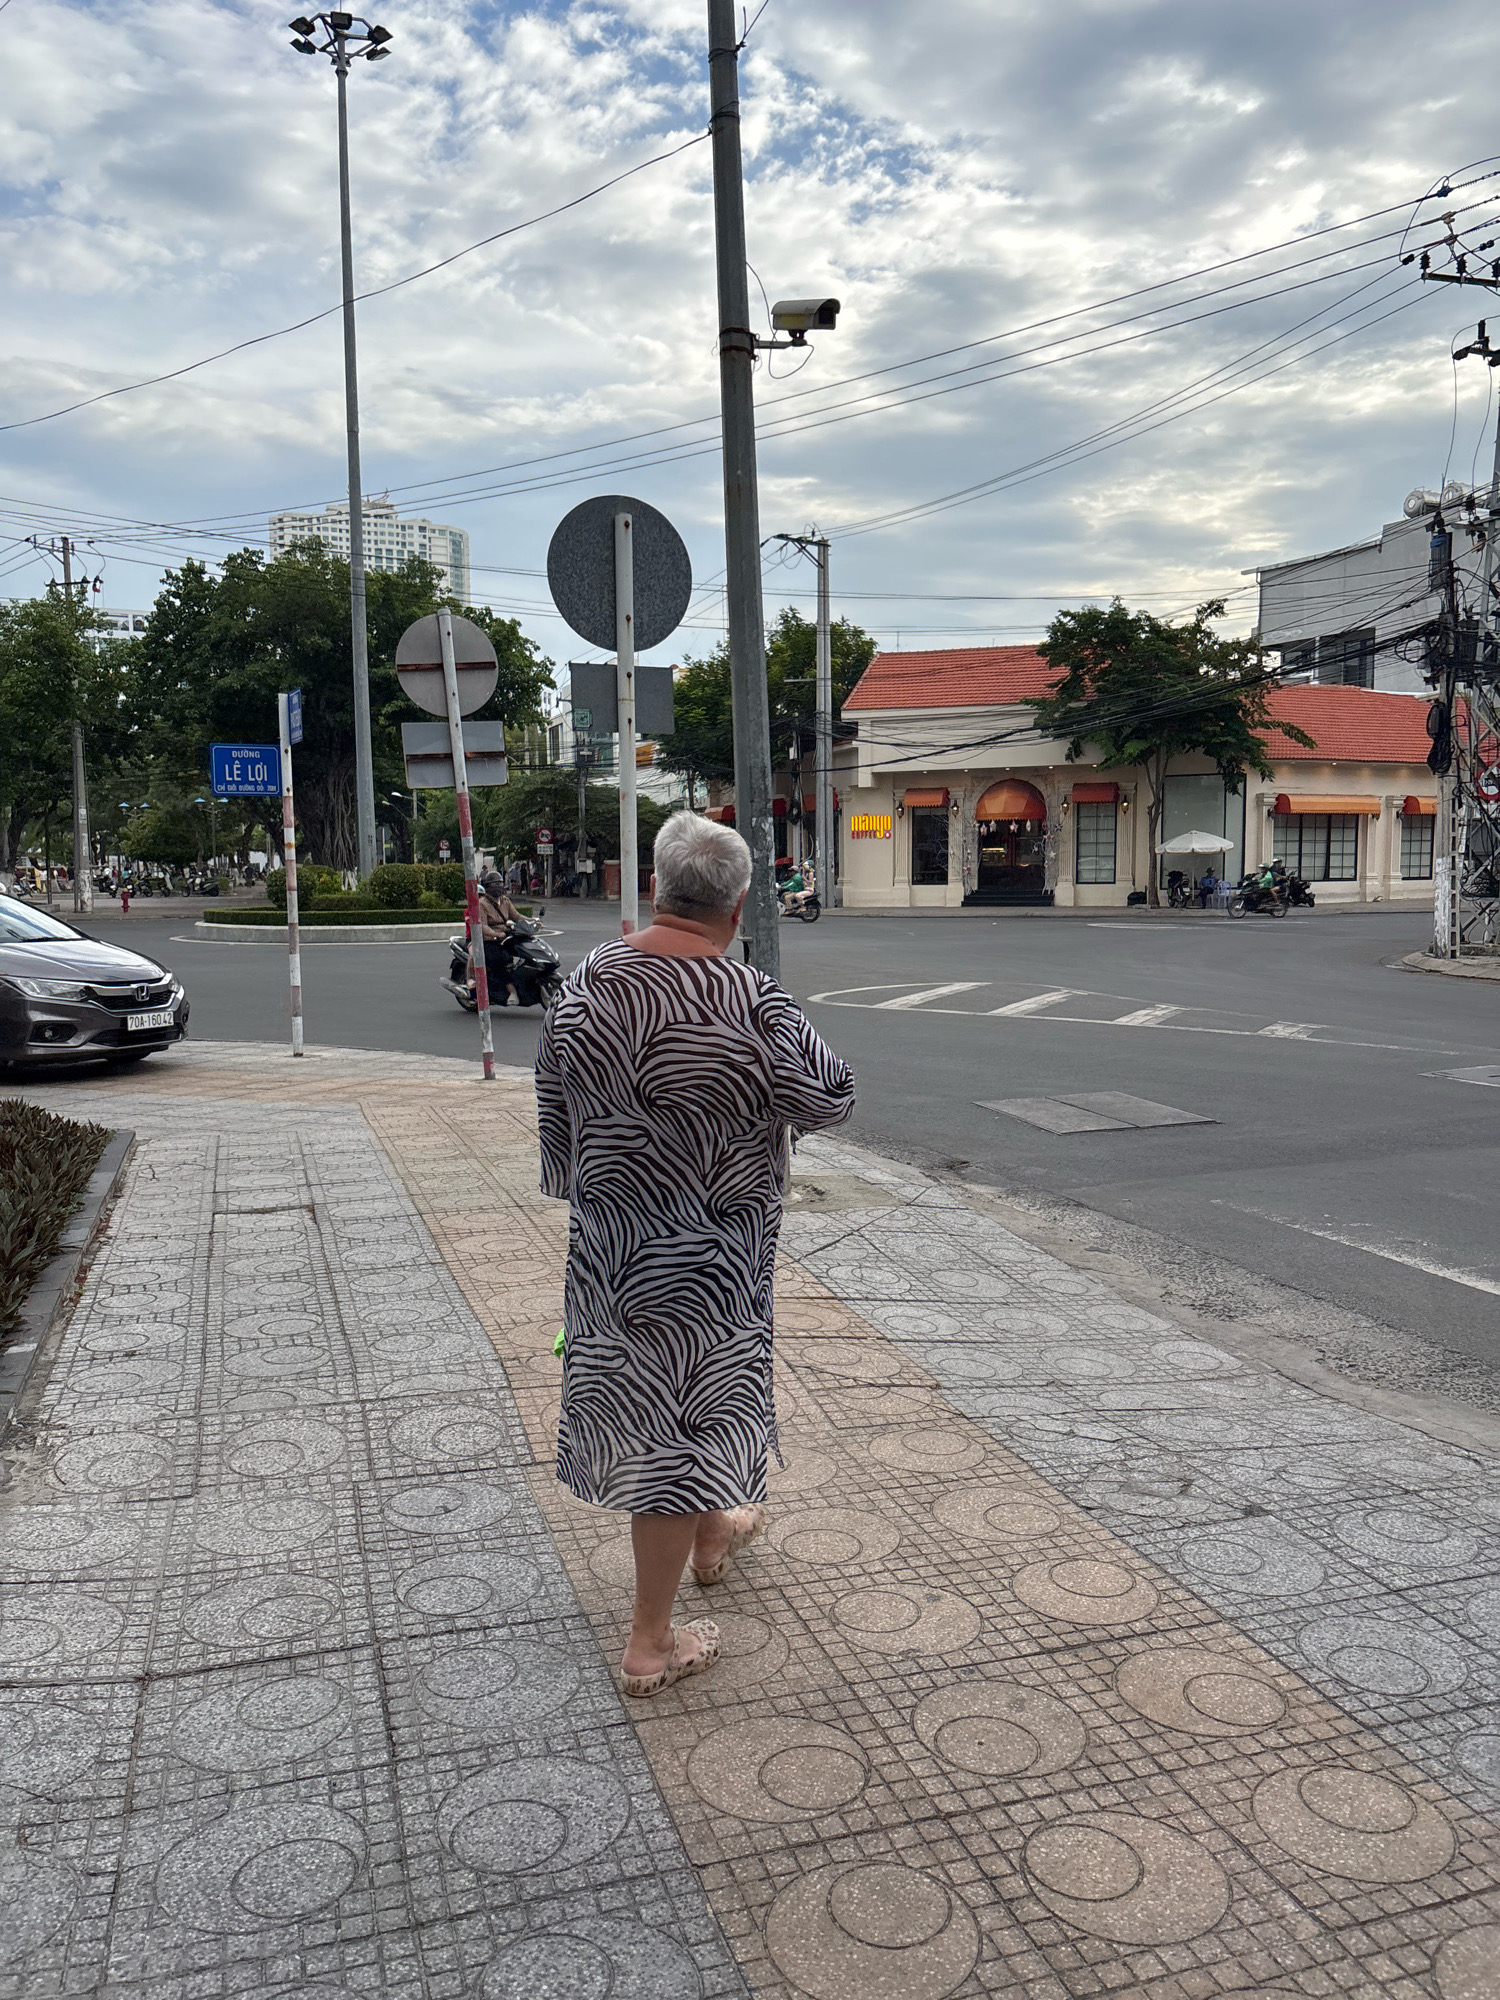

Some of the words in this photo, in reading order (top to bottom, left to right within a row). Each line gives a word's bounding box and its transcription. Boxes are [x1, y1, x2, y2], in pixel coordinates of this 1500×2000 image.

[232, 749, 260, 758] ĐƯỜNG
[225, 760, 242, 781] LÊ
[248, 762, 268, 783] LỢI
[129, 1012, 173, 1029] 70A-160.42
